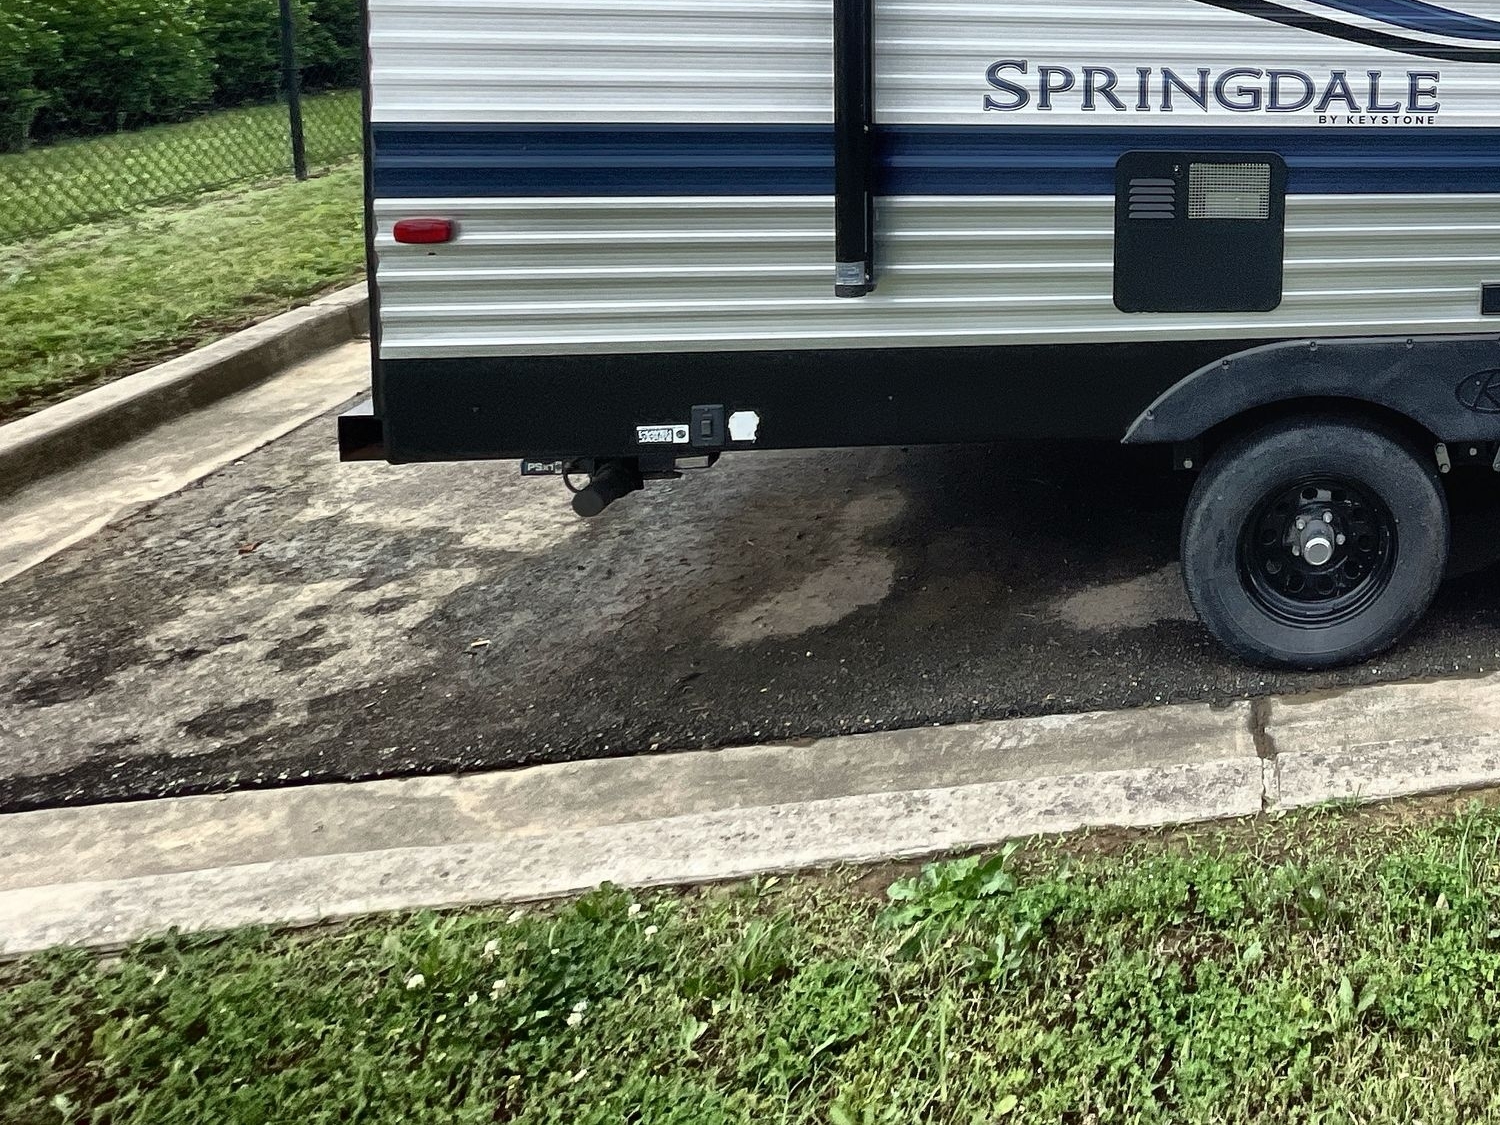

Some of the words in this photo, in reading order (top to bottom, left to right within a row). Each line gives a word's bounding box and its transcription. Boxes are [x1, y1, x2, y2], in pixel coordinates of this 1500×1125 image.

[983, 59, 1441, 114] SPRINGDALE
[1318, 115, 1338, 124] BY
[1346, 115, 1435, 125] KEYSTONE
